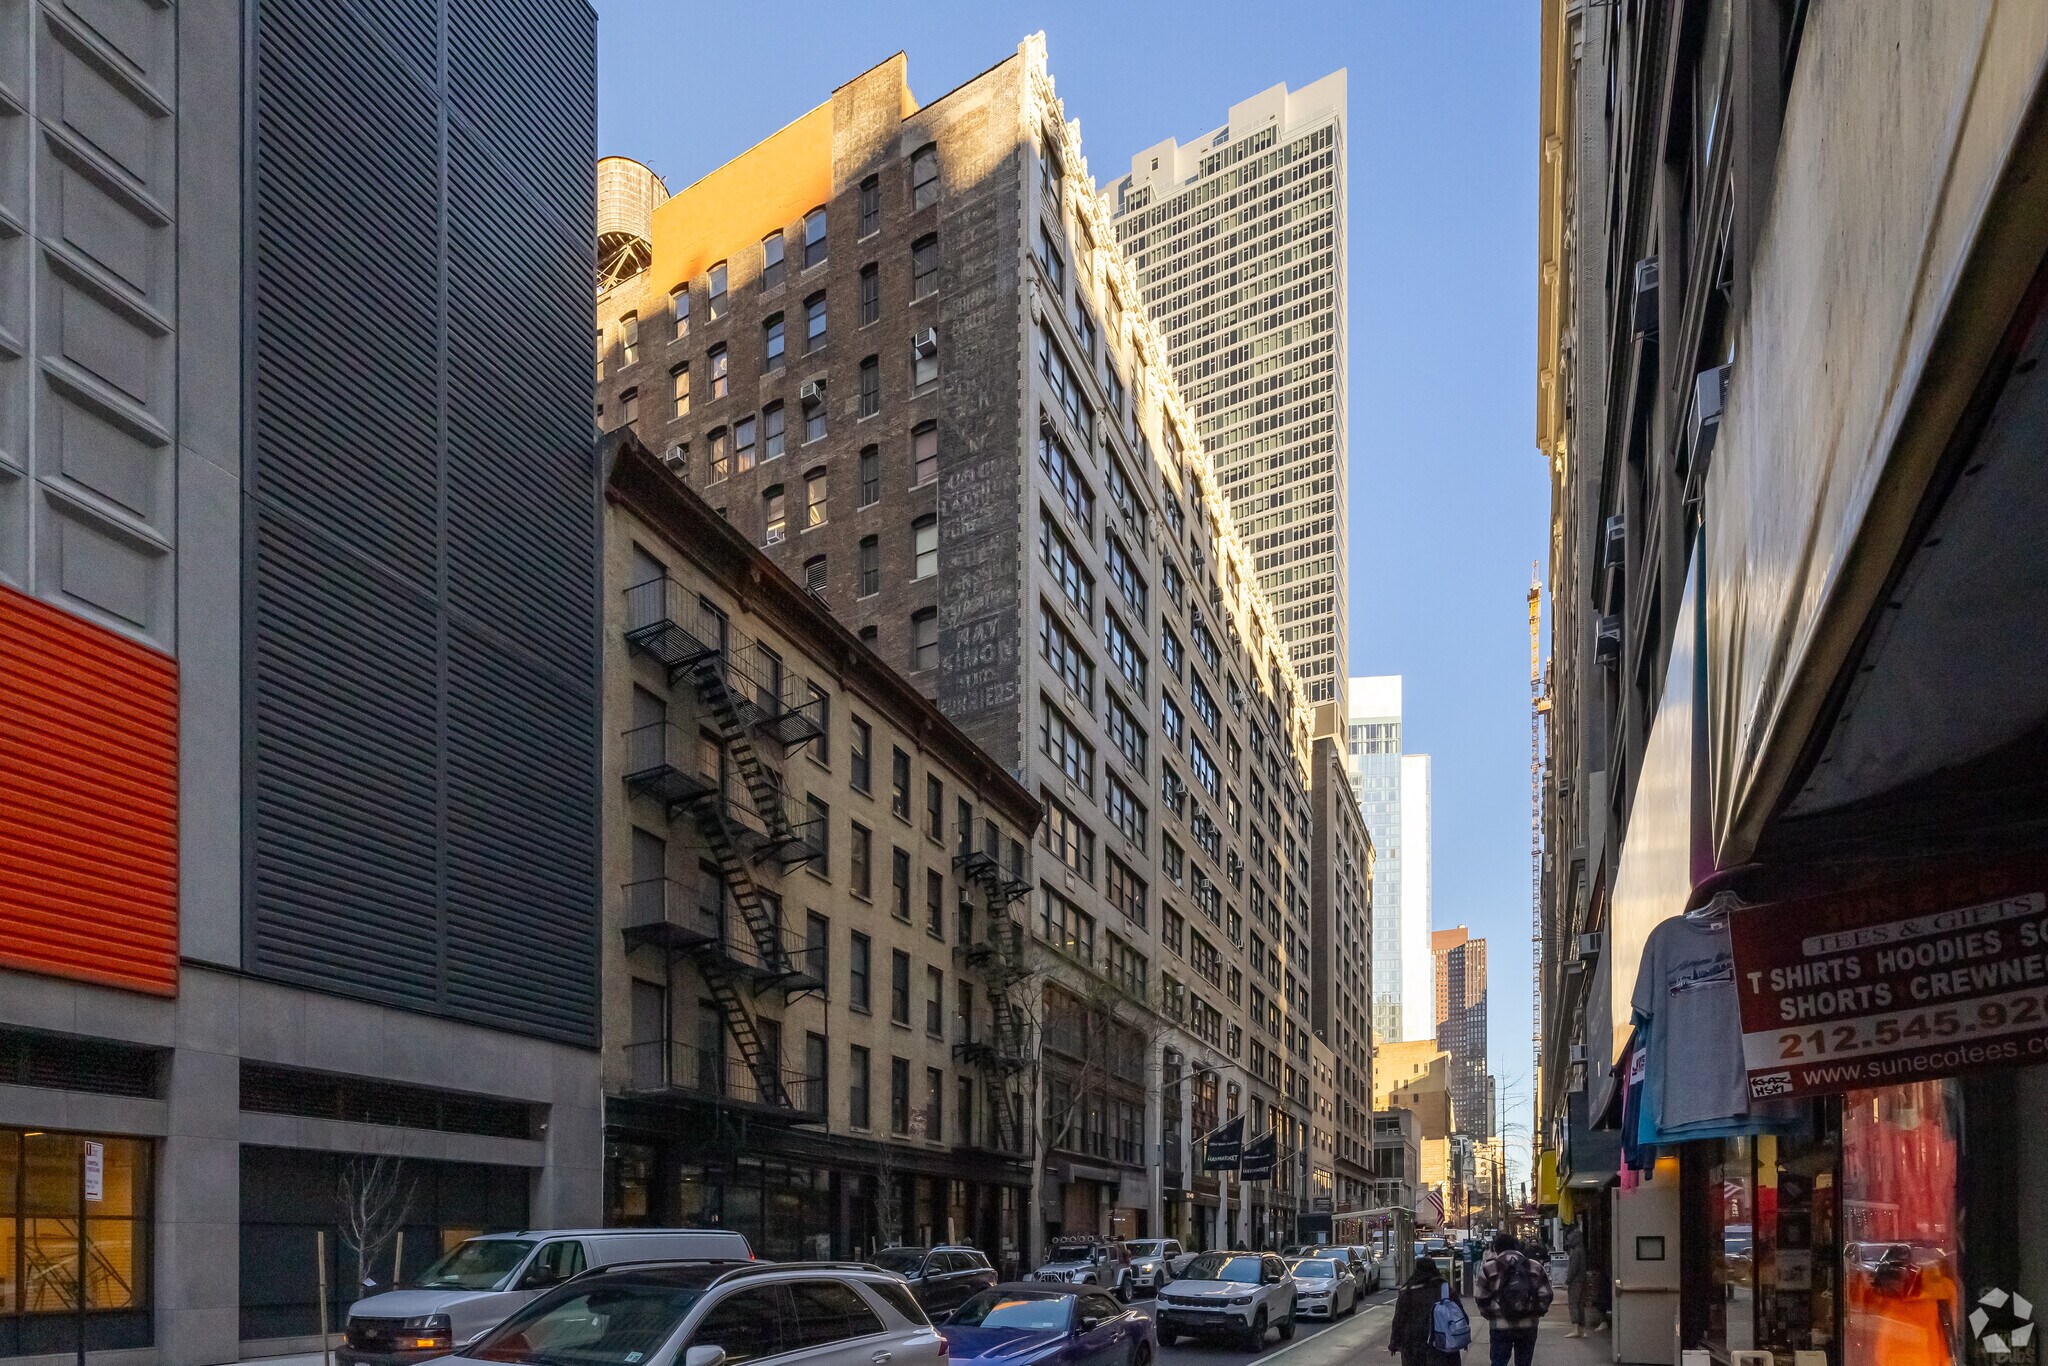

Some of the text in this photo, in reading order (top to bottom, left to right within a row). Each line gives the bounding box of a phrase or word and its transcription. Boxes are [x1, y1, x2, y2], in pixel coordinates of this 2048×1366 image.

[1812, 896, 2033, 951] TEES & GIFTS
[1746, 971, 1763, 994] T
[1770, 956, 1862, 992] SHIRTS
[1876, 930, 2002, 975] HOODIES
[1780, 953, 2048, 1021] SHORTS CREWNE
[1778, 994, 2048, 1060] 212.545.92
